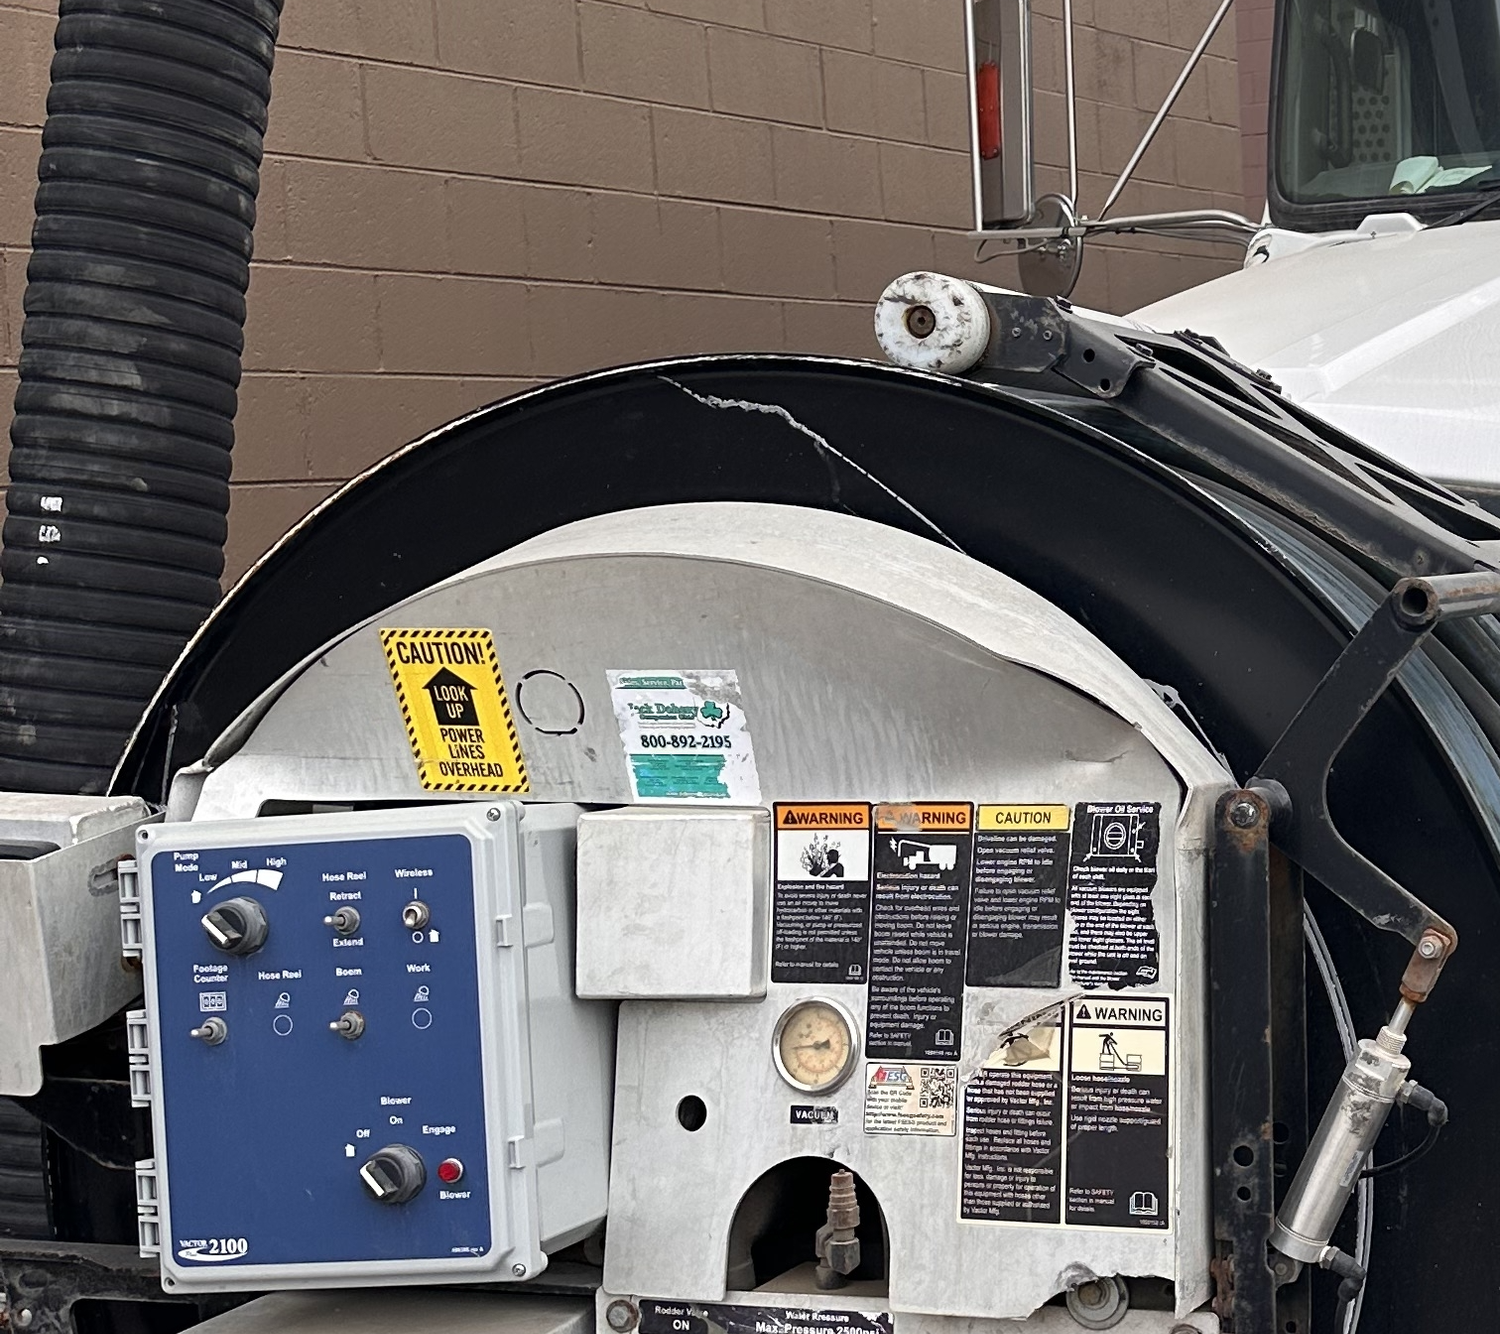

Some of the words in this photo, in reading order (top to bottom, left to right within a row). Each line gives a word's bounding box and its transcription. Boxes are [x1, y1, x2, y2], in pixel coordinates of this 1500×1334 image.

[396, 641, 486, 664] CAUTION!
[433, 685, 469, 702] LOOK
[446, 703, 464, 719] UP
[440, 728, 485, 744] POWER
[641, 734, 732, 749] 800-892-2195
[448, 744, 485, 759] LINES
[439, 761, 504, 777] OVERHEAD
[1087, 805, 1114, 814] Blower
[1114, 804, 1125, 814] Oil
[1126, 805, 1154, 814] Service
[796, 812, 864, 825] WARNING
[900, 812, 966, 825] WARNING
[995, 812, 1051, 824] CAUTION
[173, 852, 199, 861] Pump
[174, 863, 198, 872] Mode
[199, 873, 218, 882] Low
[231, 860, 248, 869] Mid
[266, 857, 287, 868] High
[394, 868, 433, 878] Wireless
[322, 873, 345, 882] Hose
[346, 871, 367, 880] Reel
[329, 891, 362, 901] Retract
[332, 937, 364, 947] Extend
[193, 964, 228, 974] Footage
[335, 967, 362, 977] Boom
[406, 963, 431, 973] Work
[193, 974, 229, 984] Counter
[258, 971, 281, 980] Hose
[282, 969, 302, 979] Reel
[1095, 1007, 1163, 1022] WARNING
[380, 1096, 412, 1106] Blower
[356, 1129, 370, 1138] Off
[389, 1115, 403, 1125] On
[422, 1125, 456, 1135] Engage
[439, 1190, 471, 1200] Blower
[179, 1240, 208, 1248] VACTOR
[209, 1238, 248, 1254] 2100
[655, 1305, 685, 1316] Rodder
[673, 1319, 690, 1331] ON
[756, 1322, 782, 1334] Max.
